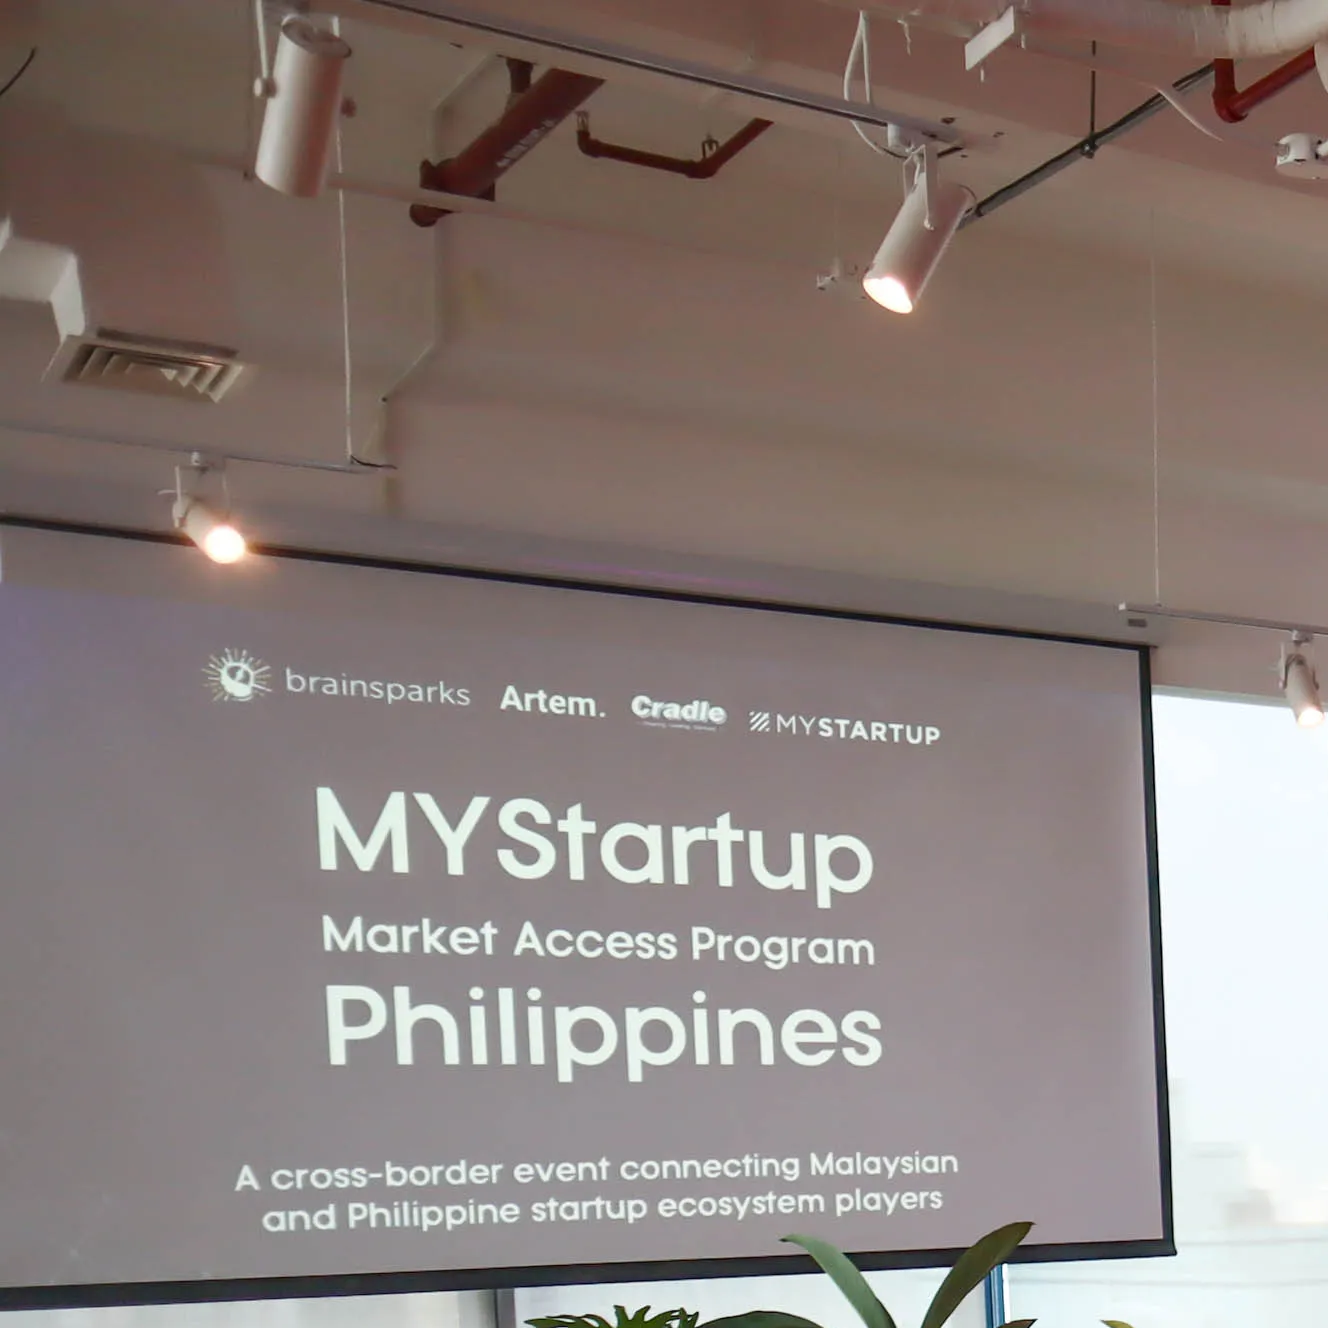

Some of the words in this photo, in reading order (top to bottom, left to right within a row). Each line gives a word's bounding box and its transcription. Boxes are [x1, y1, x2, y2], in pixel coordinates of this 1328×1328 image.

[285, 667, 471, 706] brainsparks
[500, 686, 606, 718] Artem.
[631, 695, 728, 724] Cradle
[776, 713, 941, 745] MYSTARTUP
[316, 787, 874, 909] MYStartup
[321, 914, 499, 955] Market
[513, 921, 678, 960] Access
[691, 926, 875, 970] Program
[325, 983, 883, 1083] Philippines
[234, 1164, 261, 1192] A
[270, 1159, 504, 1190] cross-border
[512, 1156, 611, 1184] event
[619, 1153, 800, 1182] connecting
[809, 1150, 959, 1180] Malaysian
[261, 1203, 336, 1232] and
[347, 1199, 521, 1232] Philippine
[531, 1195, 648, 1224] startup
[657, 1189, 826, 1221] ecosystem
[835, 1187, 944, 1217] players
